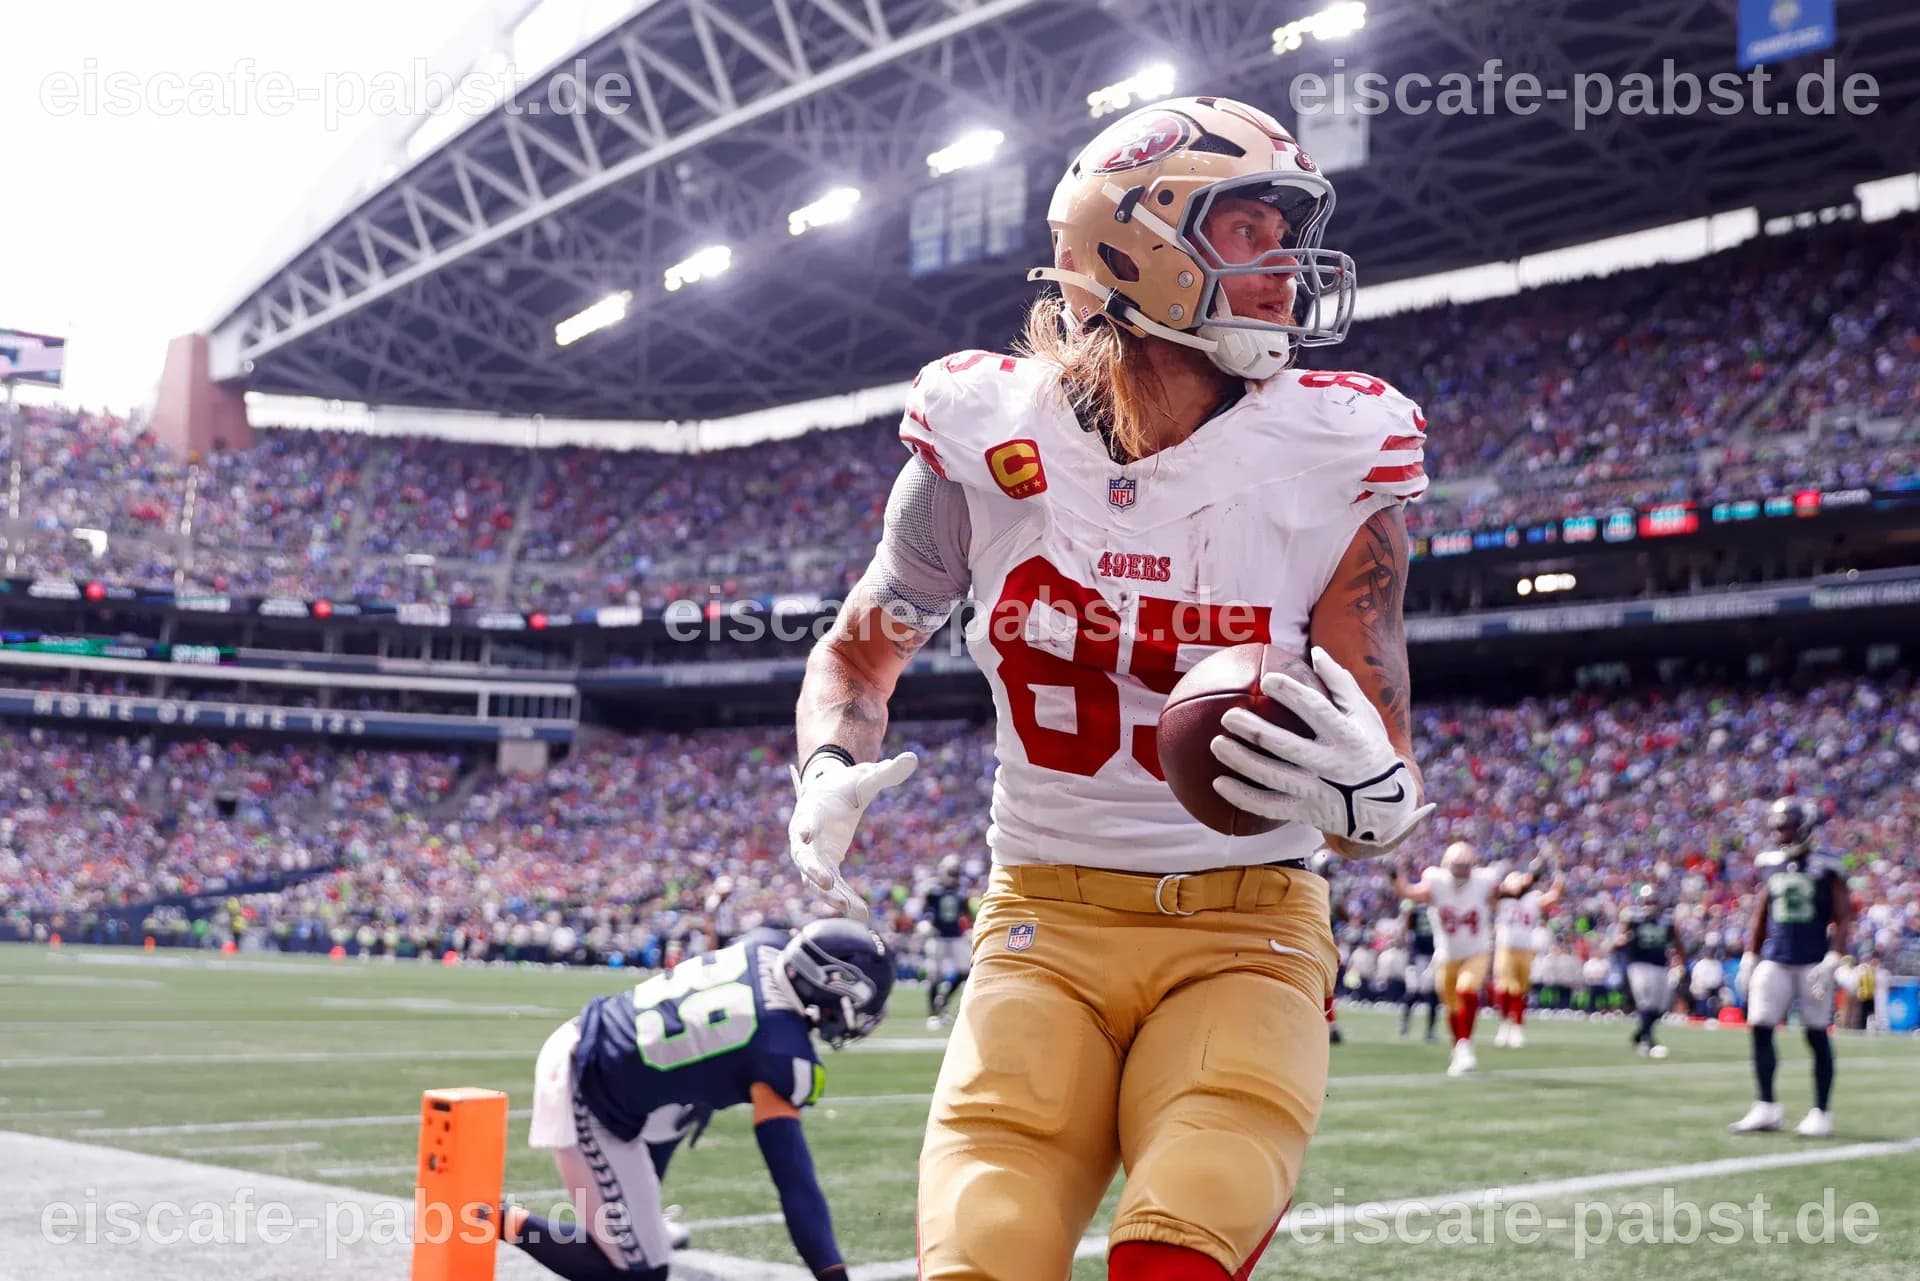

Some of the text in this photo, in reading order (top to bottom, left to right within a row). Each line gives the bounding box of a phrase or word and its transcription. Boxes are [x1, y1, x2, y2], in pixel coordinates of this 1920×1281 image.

[991, 443, 1039, 487] C
[1111, 489, 1133, 504] NFL
[1097, 551, 1171, 582] 49ERS
[989, 555, 1272, 782] 85
